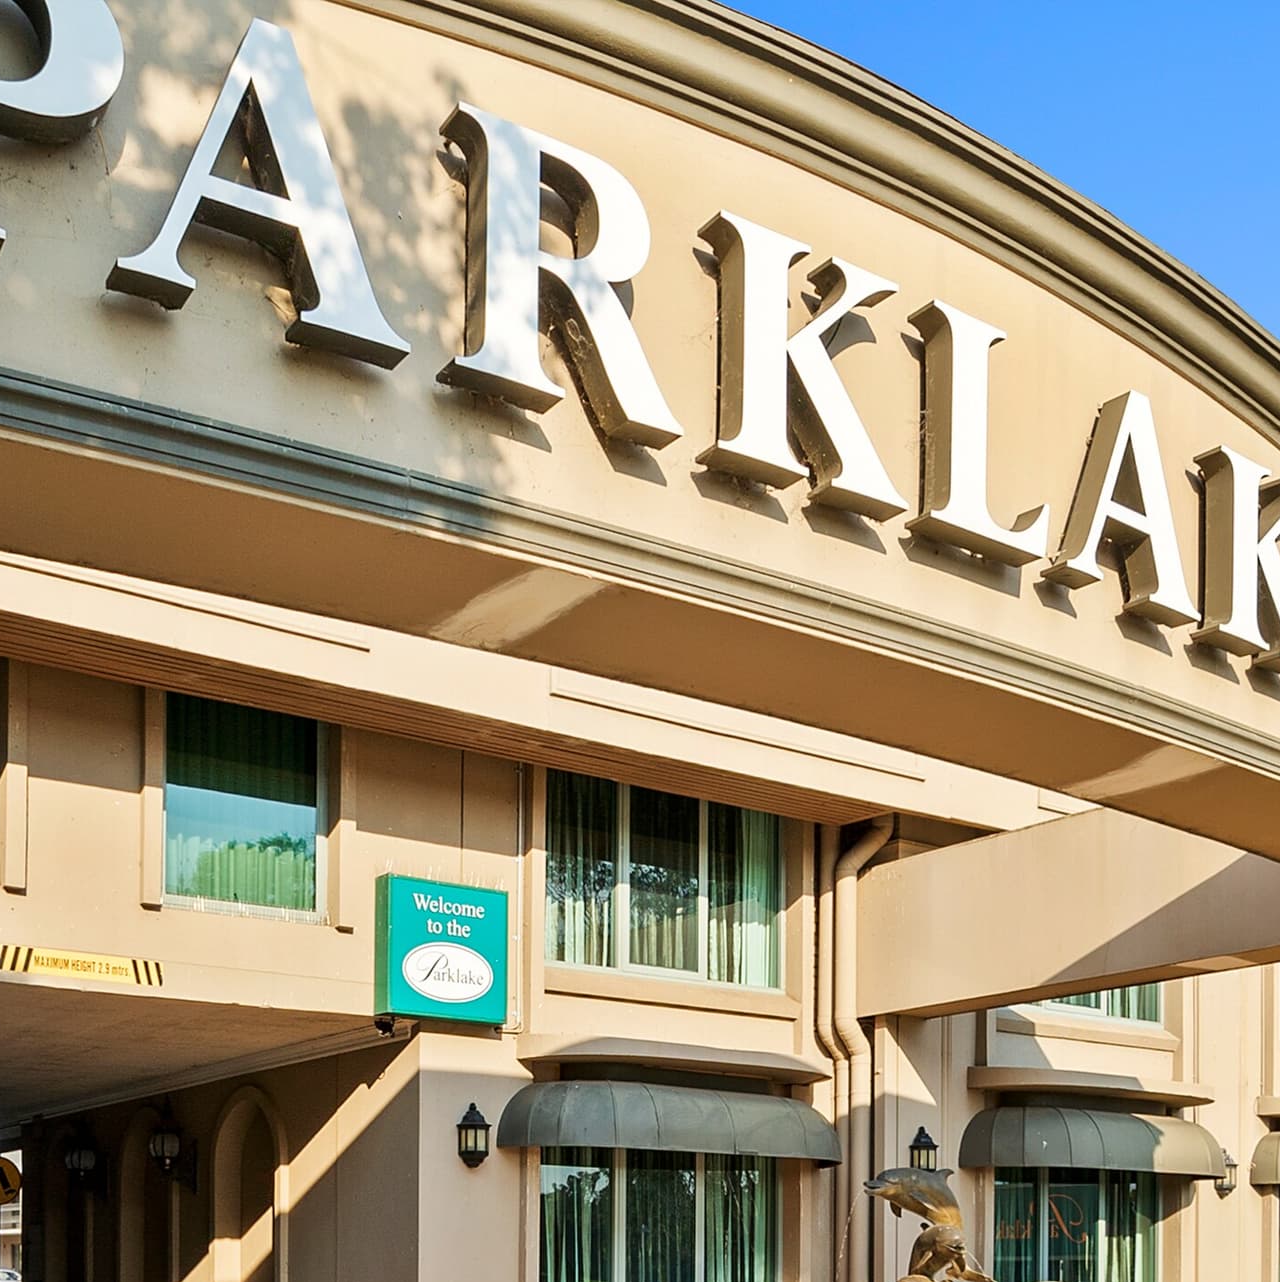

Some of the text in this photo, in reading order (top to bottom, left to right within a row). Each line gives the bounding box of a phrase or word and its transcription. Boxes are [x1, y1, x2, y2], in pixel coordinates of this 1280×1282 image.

[412, 892, 485, 919] Welcome
[427, 918, 471, 938] to the
[33, 955, 70, 970] MAXIMUM
[71, 959, 96, 974] HEIGHT
[98, 962, 110, 975] 2.9
[412, 950, 484, 986] Parklake
